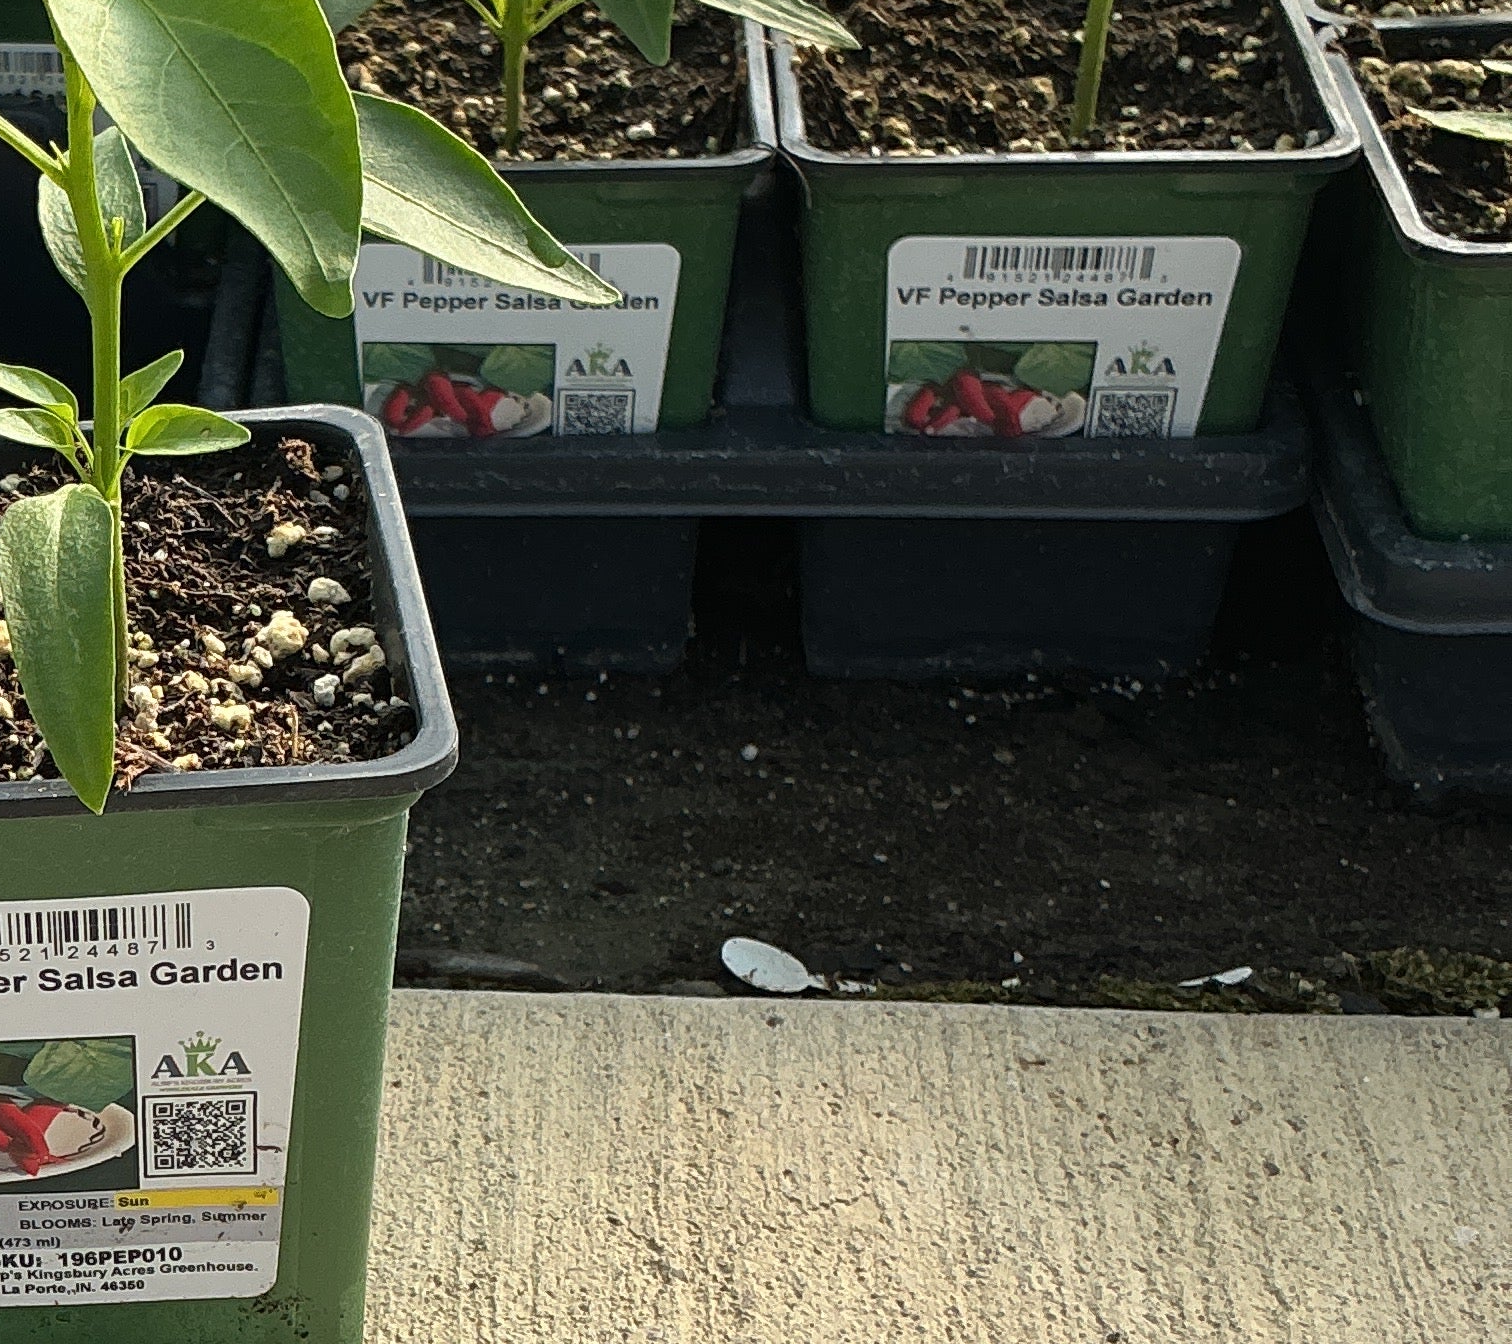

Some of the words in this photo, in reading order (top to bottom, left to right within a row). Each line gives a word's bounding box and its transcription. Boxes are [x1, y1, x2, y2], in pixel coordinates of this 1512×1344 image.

[363, 291, 394, 309] VF
[402, 293, 489, 314] Pepper
[495, 293, 562, 311] Salsa
[897, 287, 931, 305] VF
[939, 287, 1032, 310] Pepper
[1038, 288, 1108, 306] Salsa
[1117, 288, 1213, 306] Garden
[205, 939, 216, 951] 3
[38, 966, 139, 991] Salsa
[149, 958, 283, 986] Garden
[151, 1051, 253, 1079] AKA
[18, 1198, 115, 1212] EXPOSURE:
[118, 1196, 149, 1208] Sun
[20, 1217, 96, 1230] BLOOMS:
[140, 1213, 196, 1226] Spring,
[201, 1210, 267, 1223] Summer
[0, 1237, 31, 1250] (473
[36, 1237, 61, 1249] ml)
[56, 1247, 183, 1268] 196PEP010
[27, 1268, 108, 1282] Kingsbury
[111, 1266, 155, 1278] Acres
[159, 1262, 259, 1275] Greenhouse.
[2, 1284, 20, 1295] La
[100, 1280, 145, 1292] 46350
